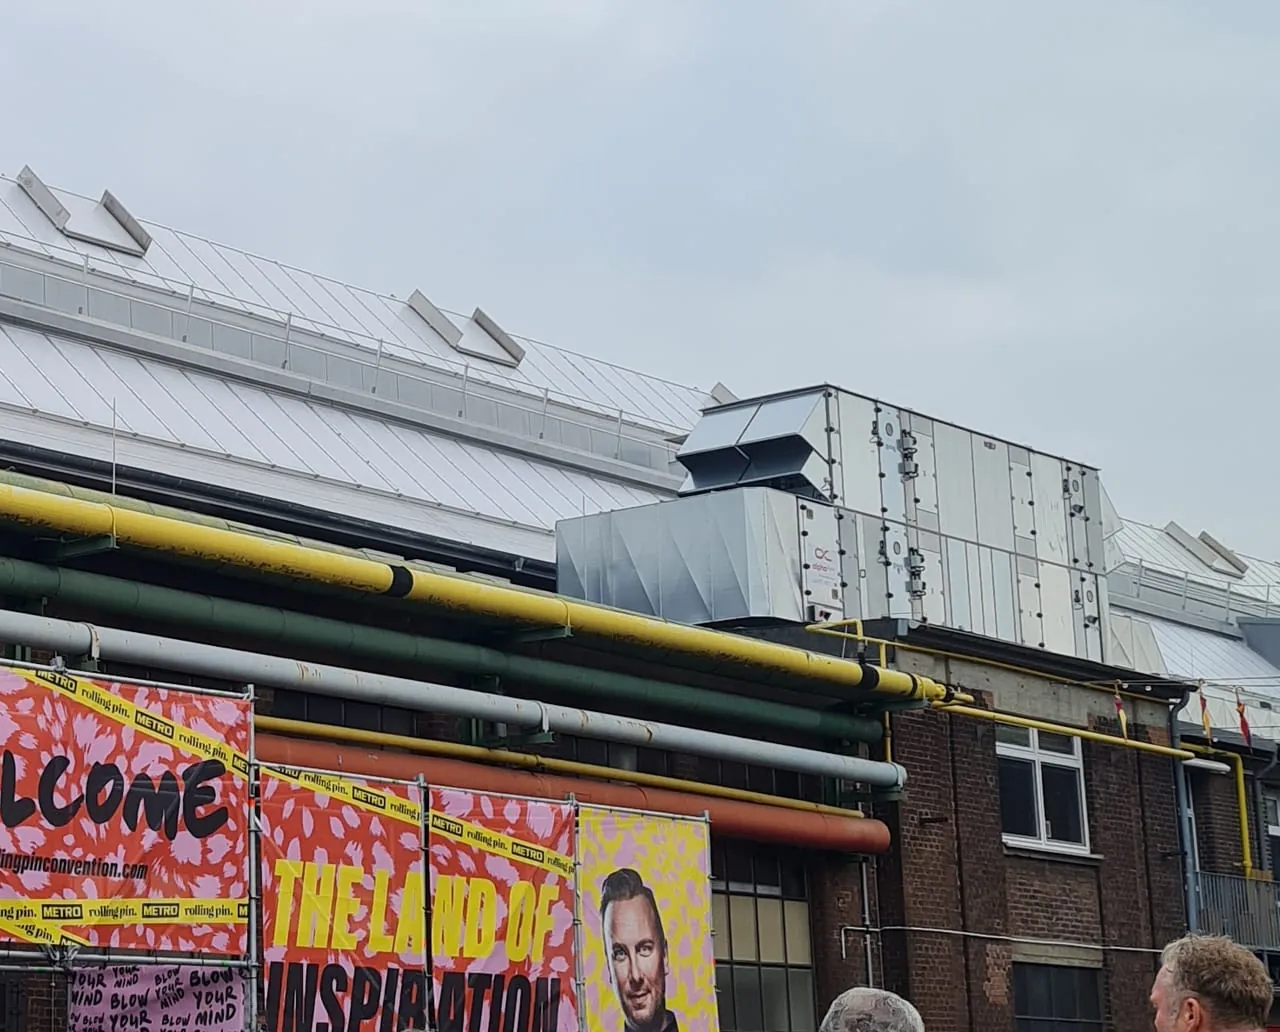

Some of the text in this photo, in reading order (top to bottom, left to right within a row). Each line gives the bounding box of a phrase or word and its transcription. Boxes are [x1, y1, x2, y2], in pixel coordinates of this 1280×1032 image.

[81, 688, 111, 712] rolling
[136, 712, 173, 736] METRO
[179, 733, 211, 756] rolling
[304, 773, 331, 791] rolling
[353, 788, 385, 807] METRO
[390, 802, 417, 820] rolling
[432, 816, 462, 835] METRO
[467, 830, 492, 847] rolling
[512, 844, 543, 861] METRO
[42, 906, 82, 918] METRO
[89, 905, 119, 919] rolling
[143, 905, 179, 917] METRO
[184, 905, 214, 919] rolling
[273, 858, 560, 963] THE LAND OF
[114, 974, 138, 988] MIND
[154, 965, 181, 986] BLOW
[189, 967, 234, 987] BLOW
[110, 987, 150, 1010] BLOW
[155, 978, 183, 1000] YOUR
[160, 989, 185, 1009] MIND
[193, 986, 237, 1010] YOUR
[109, 1010, 152, 1032] YOUR
[161, 1013, 190, 1026] BLOW
[195, 1003, 237, 1026] MIND
